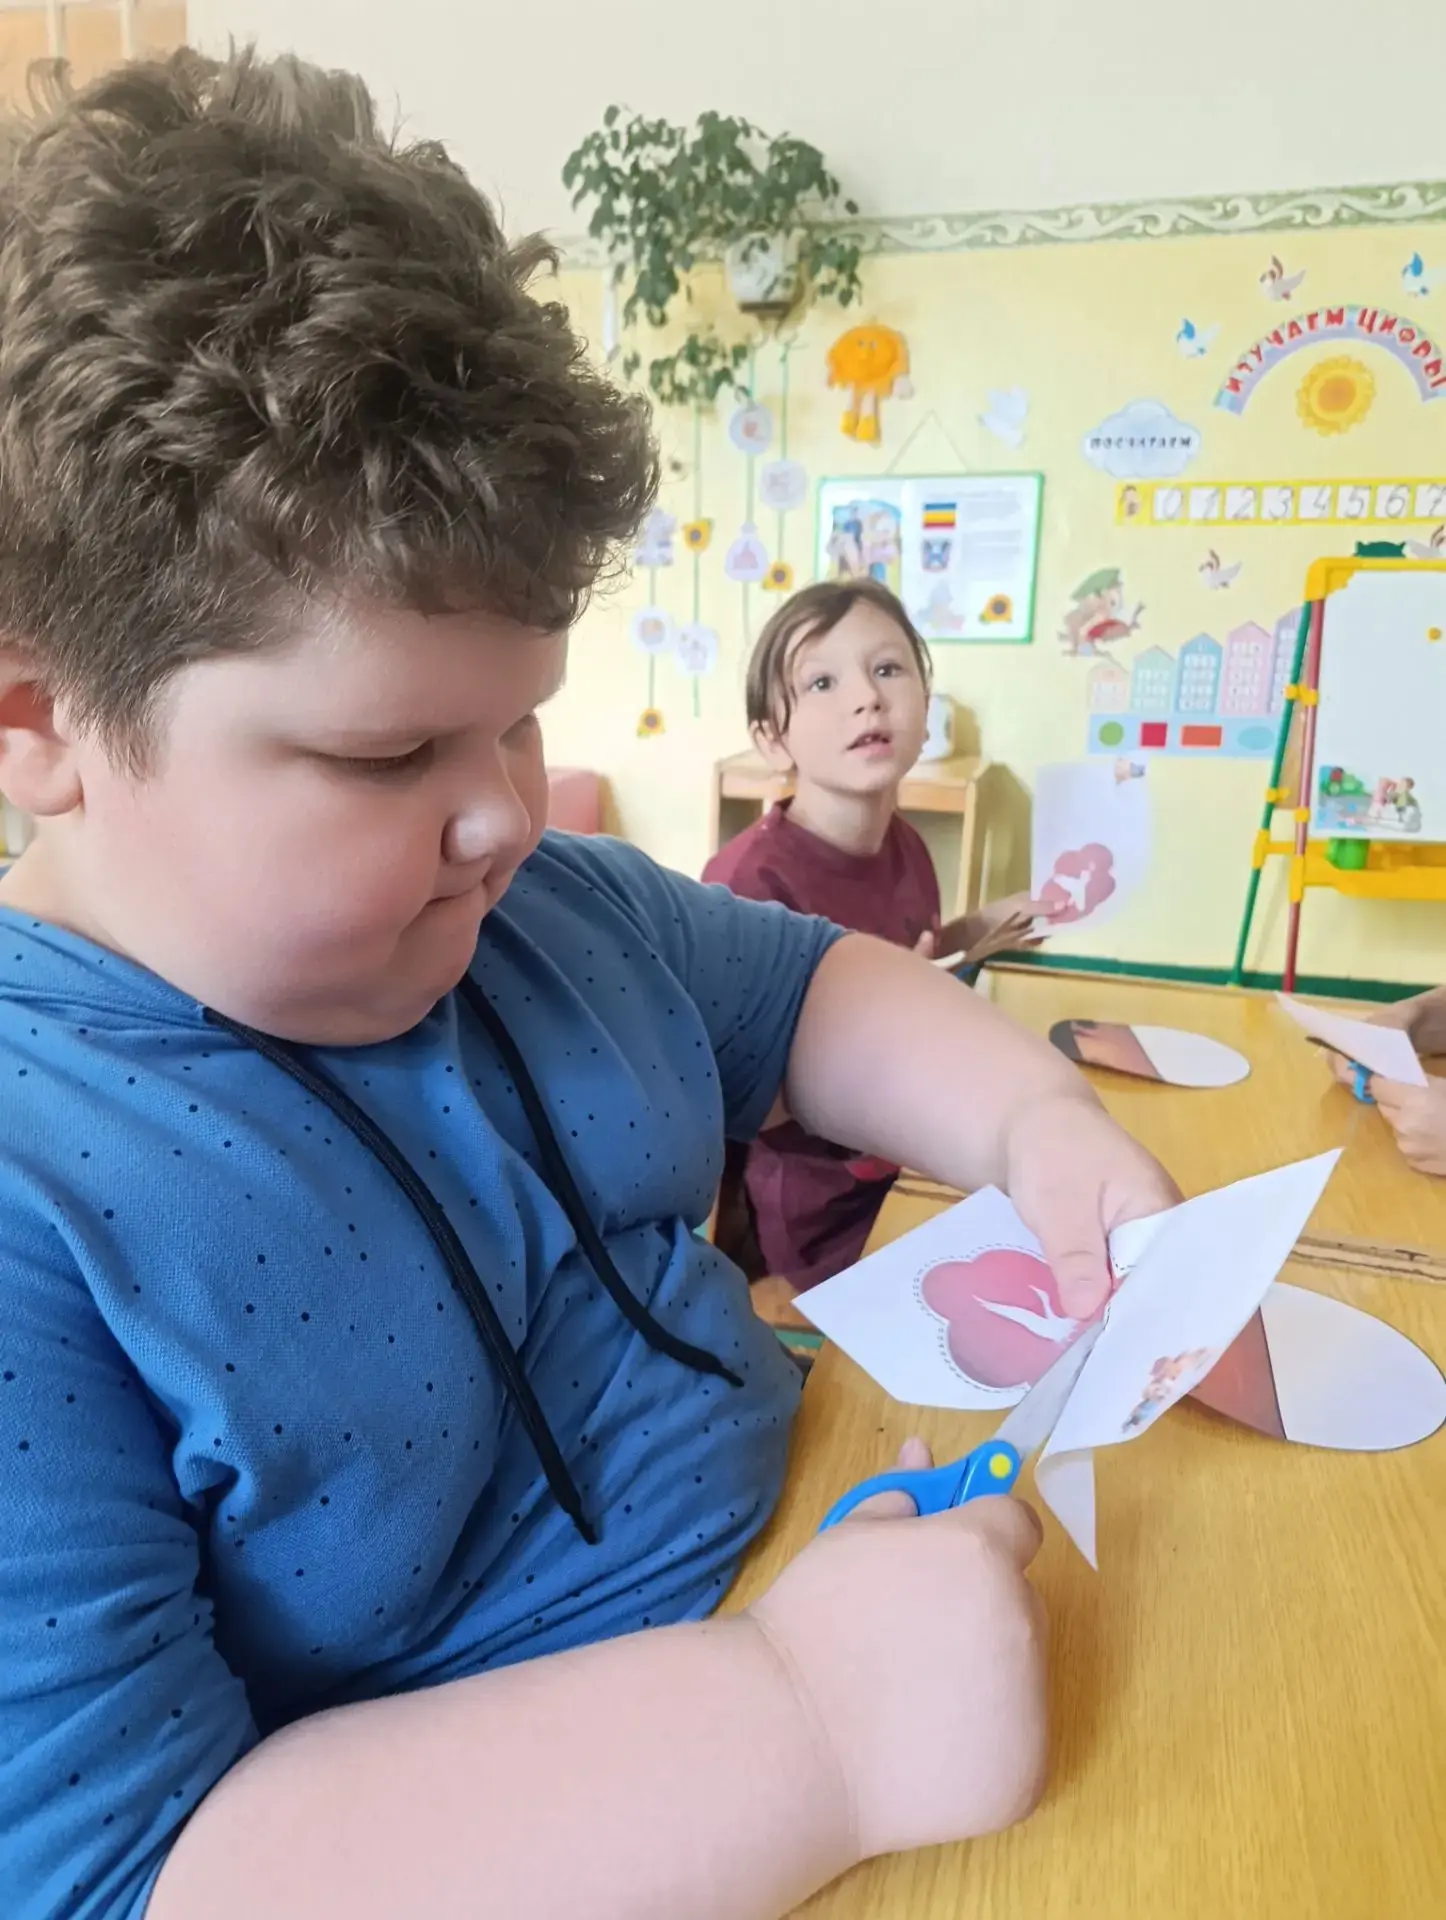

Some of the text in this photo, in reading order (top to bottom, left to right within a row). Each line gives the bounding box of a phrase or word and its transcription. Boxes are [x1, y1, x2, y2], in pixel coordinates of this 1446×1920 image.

[1162, 484, 1184, 519] 0
[1202, 485, 1219, 519] 1
[1232, 486, 1257, 519] 2
[1268, 485, 1294, 519] 3
[1313, 485, 1332, 518] 4
[1345, 484, 1371, 518] 5
[1385, 483, 1410, 518] 6
